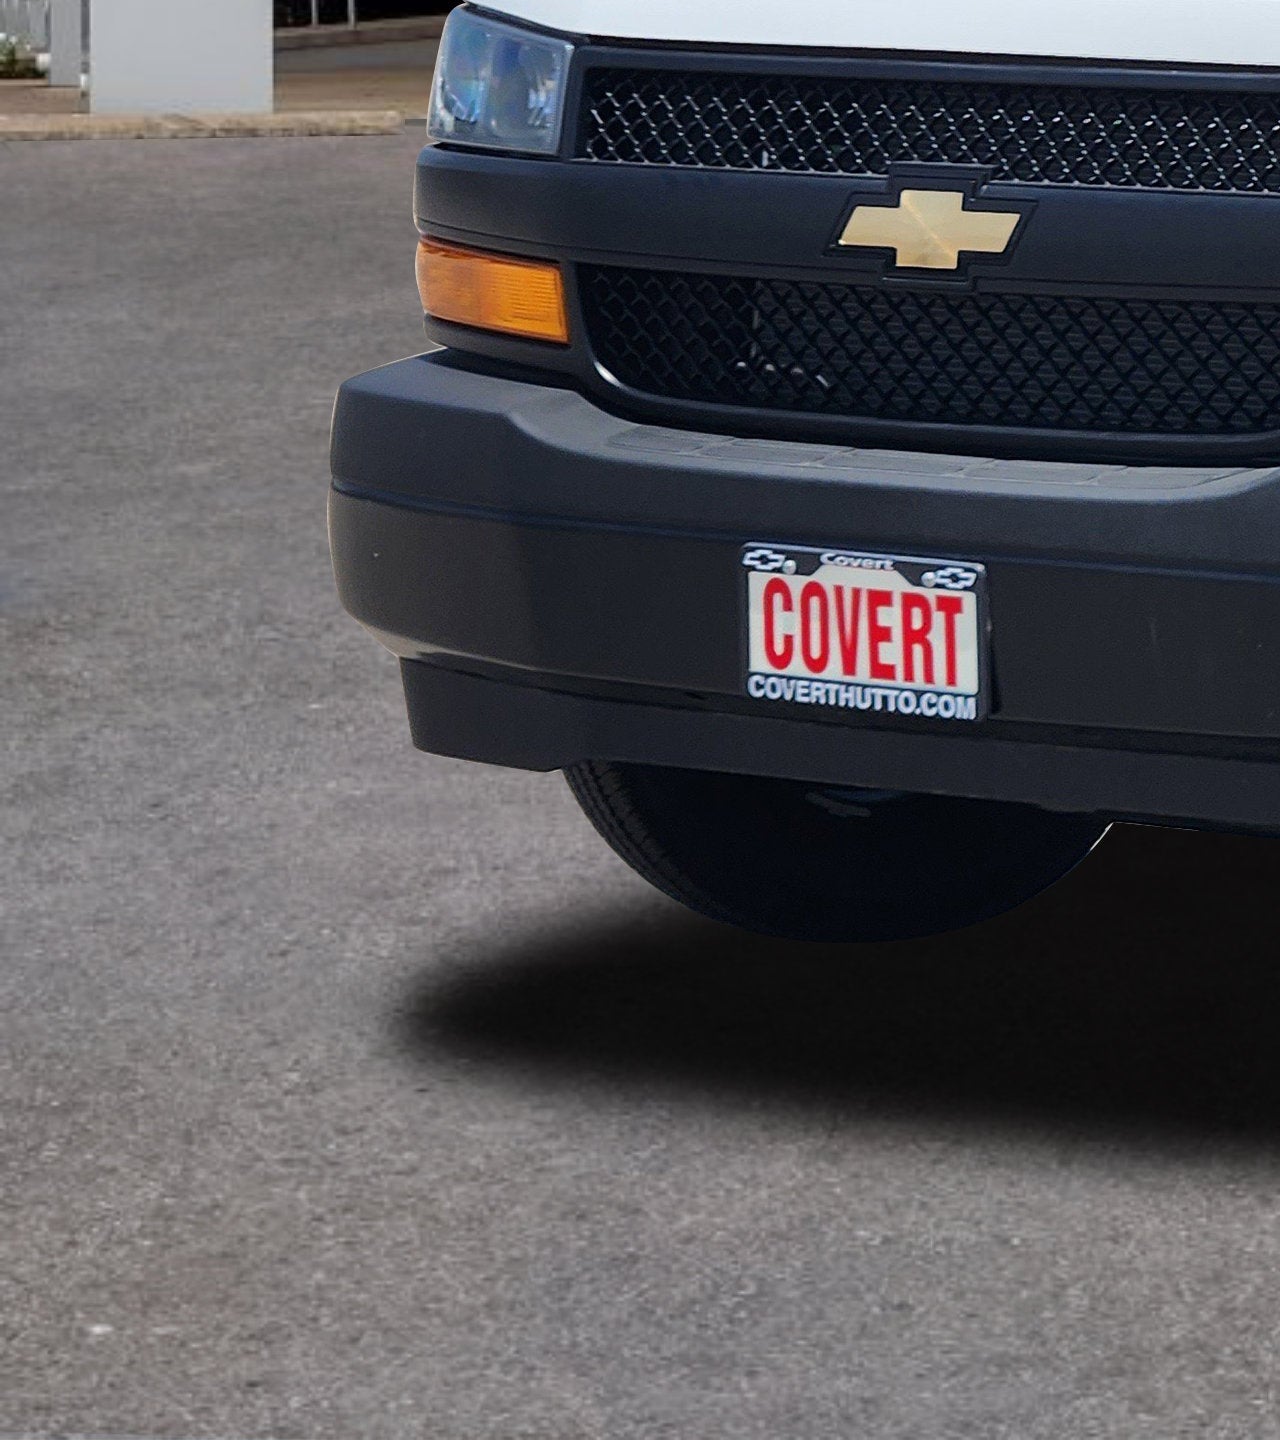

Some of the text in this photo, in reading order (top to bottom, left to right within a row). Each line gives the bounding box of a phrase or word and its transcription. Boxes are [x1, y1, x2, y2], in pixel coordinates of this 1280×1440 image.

[819, 552, 896, 571] Covert
[763, 577, 964, 687] COVERT
[747, 674, 977, 721] COVERTHUTTO.COM
